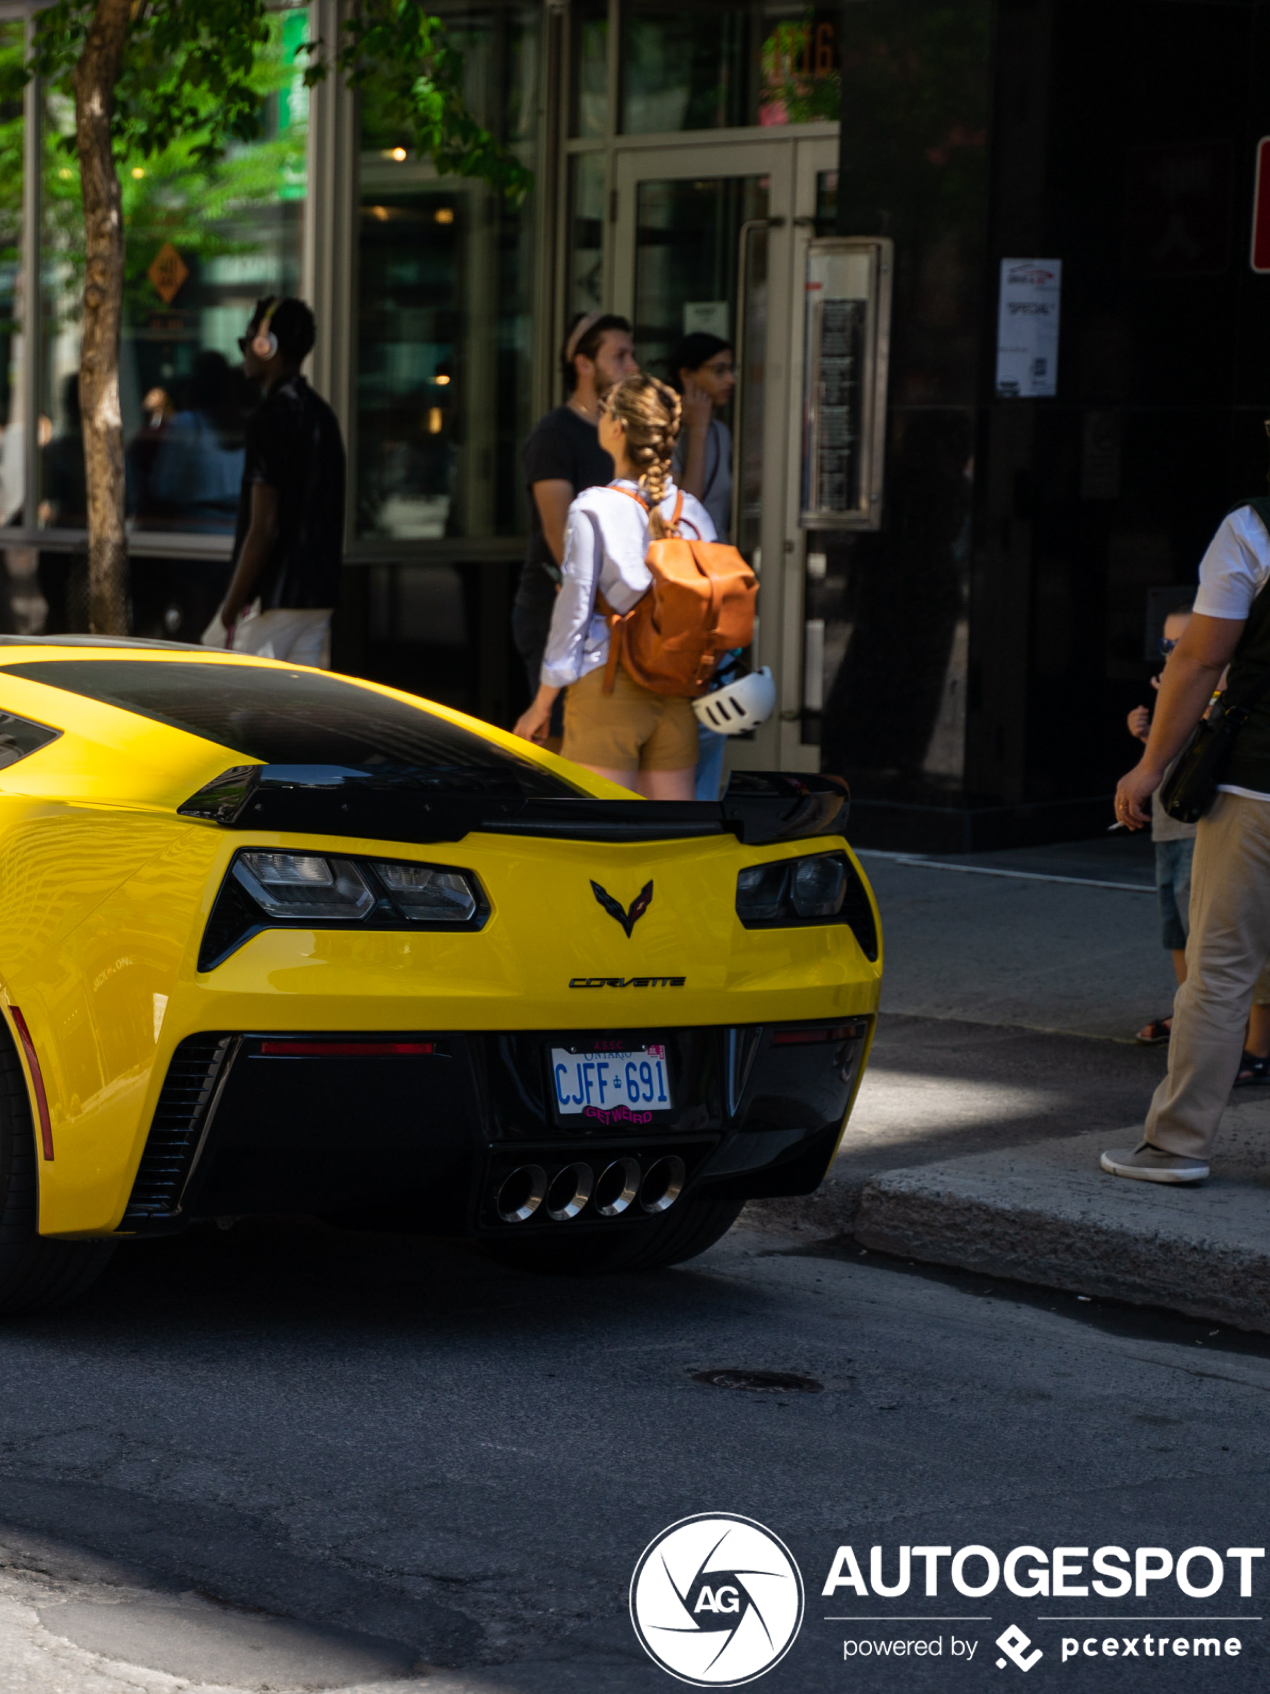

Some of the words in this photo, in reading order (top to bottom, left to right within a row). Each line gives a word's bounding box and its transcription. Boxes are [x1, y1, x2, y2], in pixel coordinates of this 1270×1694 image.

[569, 976, 687, 988] CORVETTE
[556, 1063, 610, 1105] CJFF
[625, 1061, 667, 1102] 691
